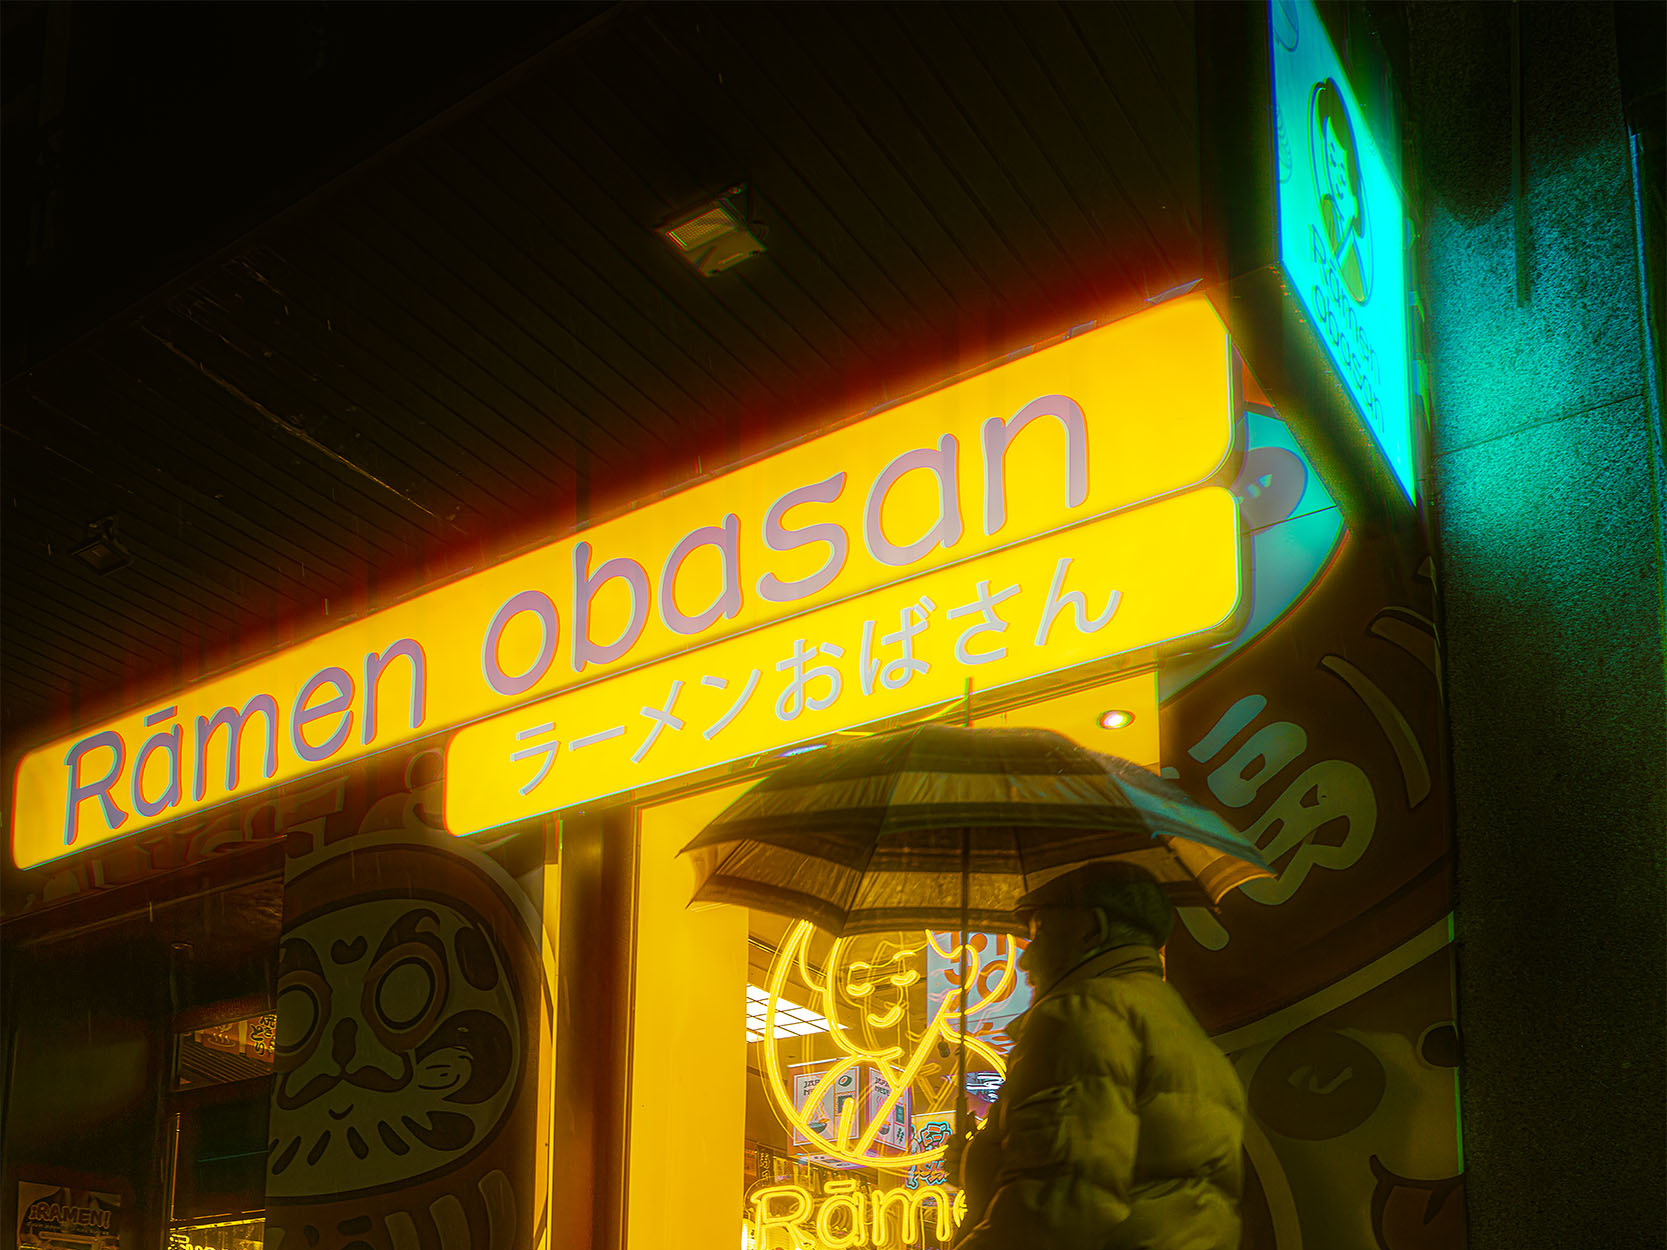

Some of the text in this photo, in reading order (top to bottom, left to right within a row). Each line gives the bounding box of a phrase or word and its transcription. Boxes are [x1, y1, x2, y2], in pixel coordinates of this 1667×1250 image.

[1309, 223, 1381, 386] Rāmen
[1312, 284, 1385, 434] obasan
[65, 394, 1089, 846] Rāmen obasan
[510, 557, 1122, 796] ラーメンおばさん
